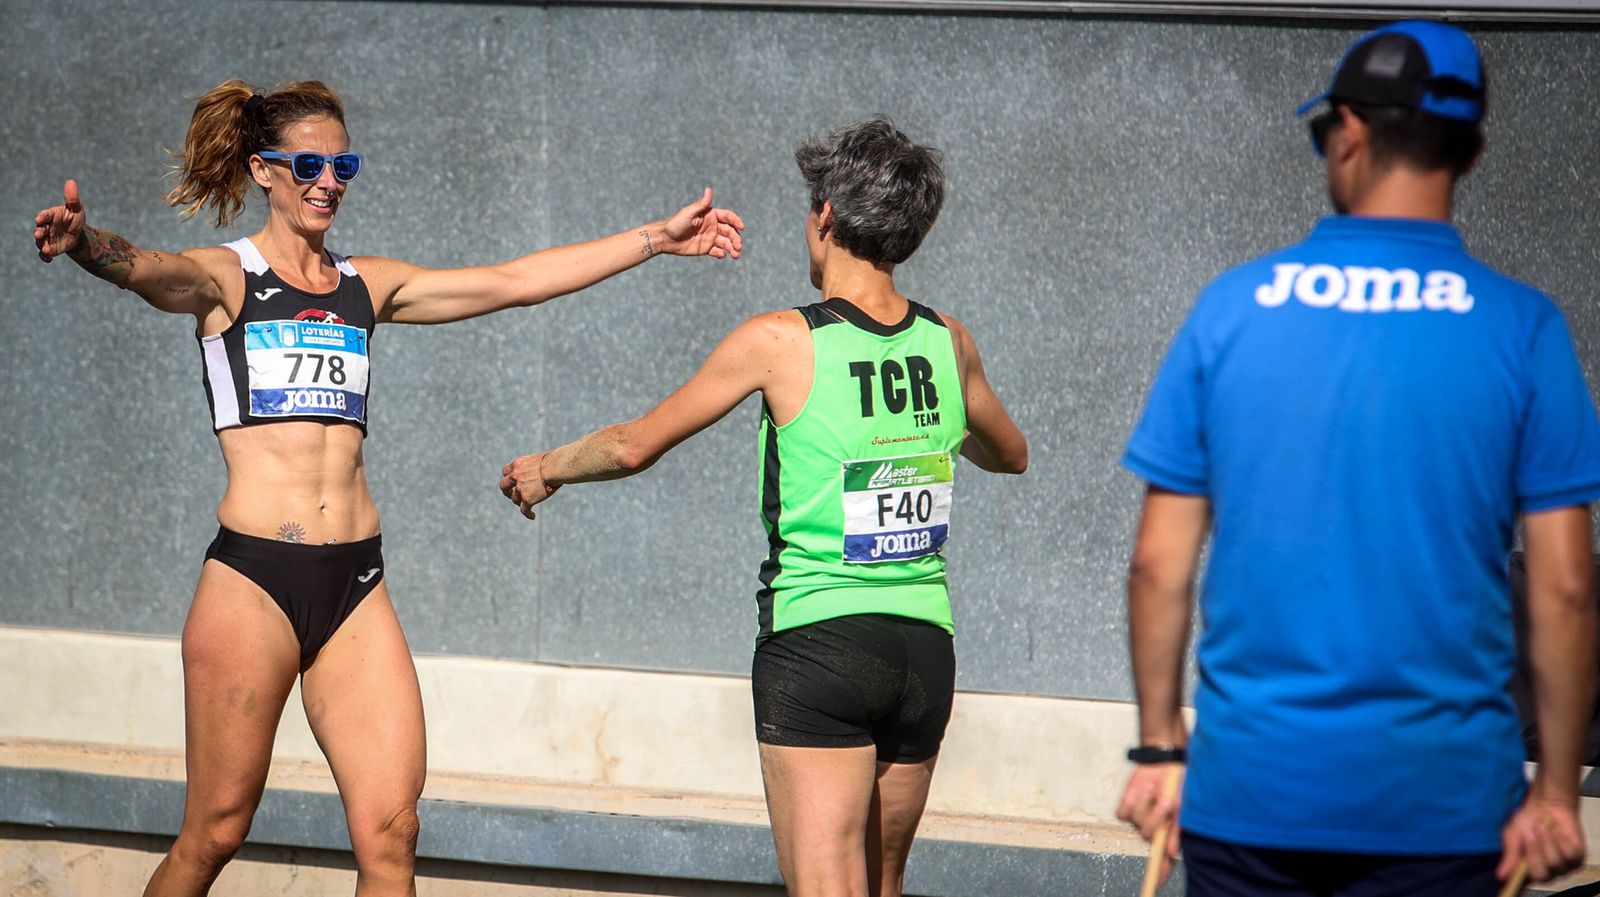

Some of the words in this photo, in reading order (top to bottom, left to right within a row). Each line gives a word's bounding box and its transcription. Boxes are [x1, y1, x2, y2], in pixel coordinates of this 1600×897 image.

[301, 327, 345, 338] LOTERÍAS
[283, 353, 347, 385] 778
[849, 355, 939, 418] TCR
[914, 412, 940, 428] TEAM
[877, 489, 933, 527] F40
